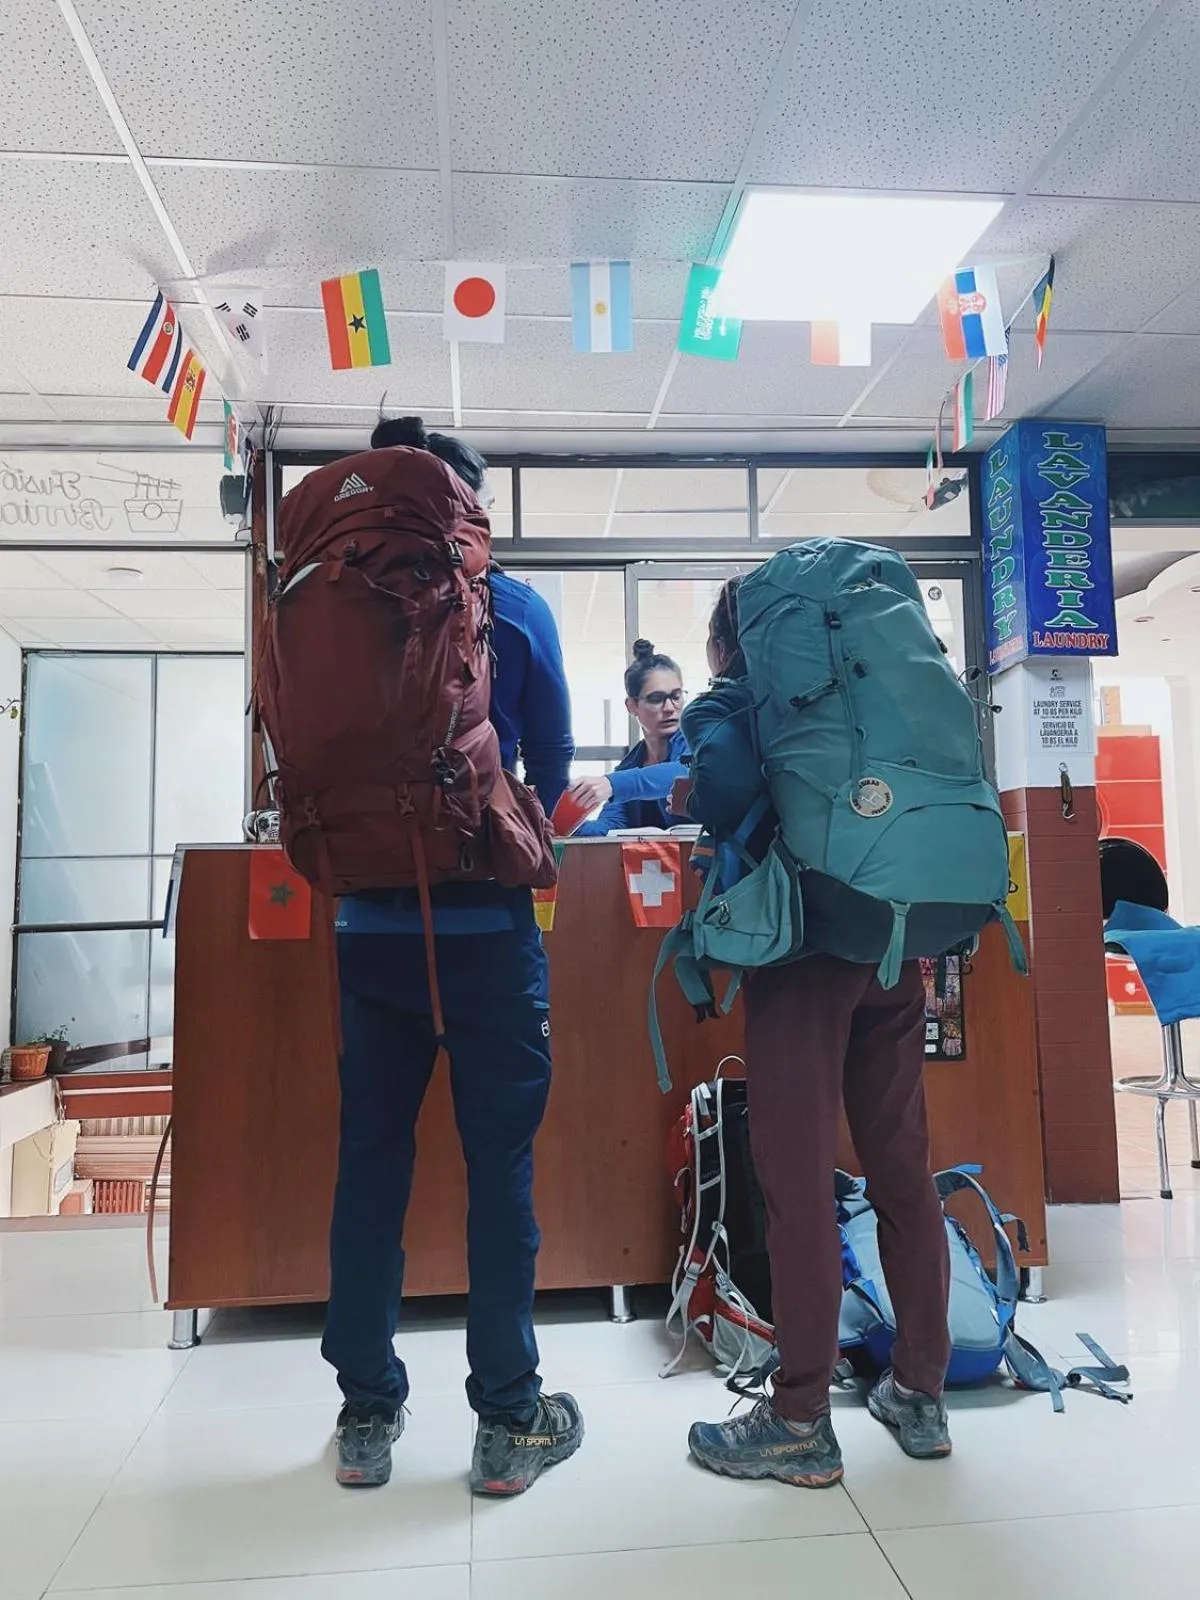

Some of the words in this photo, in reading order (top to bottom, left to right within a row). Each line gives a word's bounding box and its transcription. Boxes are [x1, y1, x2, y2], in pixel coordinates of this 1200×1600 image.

[334, 486, 374, 501] GREGORY
[1038, 432, 1098, 627] LAVANDERIA
[989, 449, 1017, 640] LAUNDRY
[1033, 632, 1109, 649] LAUNDRY
[1033, 700, 1058, 708] LAUNDRY
[1060, 700, 1082, 708] SERVICE
[1042, 721, 1067, 729] SERVICIO
[1068, 721, 1075, 729] DE
[1065, 736, 1079, 744] KILO
